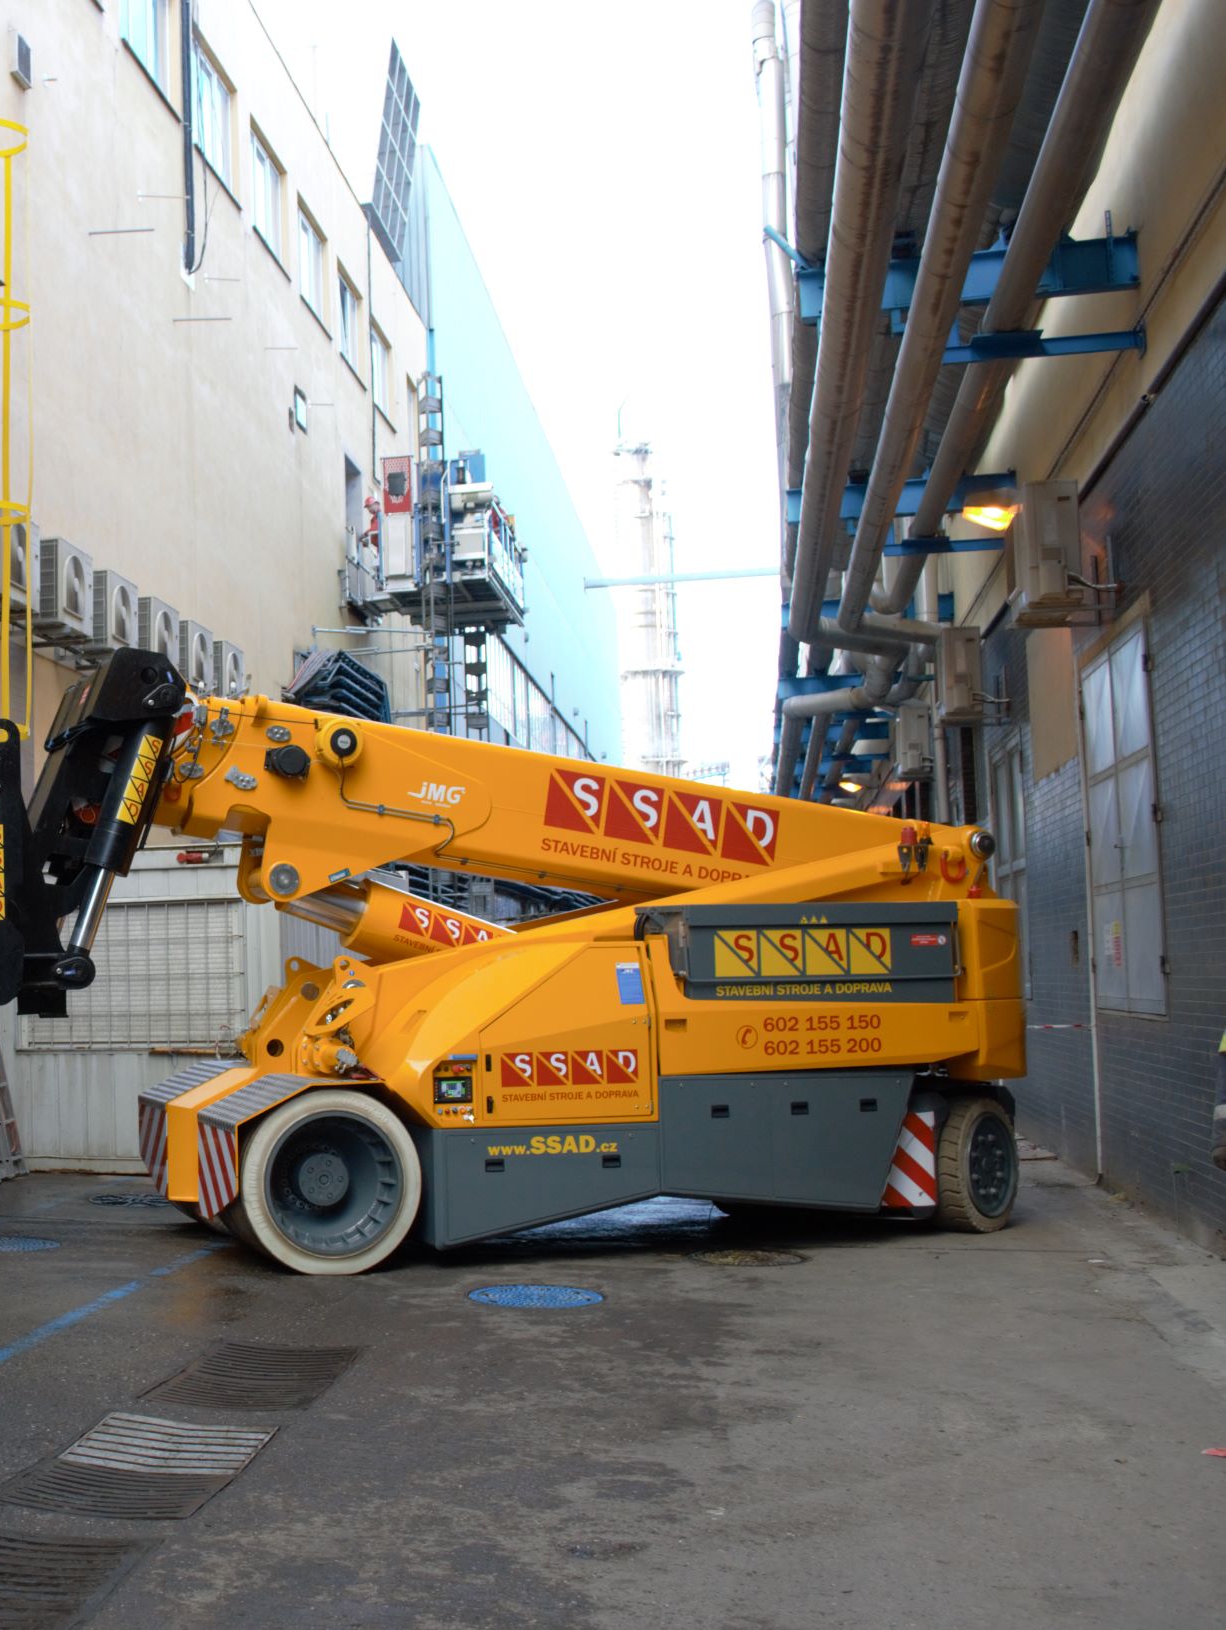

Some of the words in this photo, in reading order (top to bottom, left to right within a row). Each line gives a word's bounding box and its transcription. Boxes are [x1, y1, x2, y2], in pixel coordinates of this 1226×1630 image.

[573, 777, 774, 849] SSAD
[541, 837, 619, 864] STAVEBNÍ
[620, 852, 678, 874] STROJE
[682, 864, 693, 877] A
[698, 866, 751, 883] DOPR
[415, 907, 489, 942] SSA
[733, 932, 888, 963] SSAD
[716, 984, 774, 997] STAVEBNÍ
[776, 984, 822, 996] STROJE
[824, 984, 834, 995] A
[836, 982, 892, 994] DOPRAVA
[763, 1016, 799, 1032] 602
[805, 1015, 841, 1031] 155
[846, 1014, 881, 1030] 150
[764, 1040, 800, 1056] 602
[806, 1039, 841, 1055] 155
[846, 1037, 882, 1053] 200
[514, 1051, 636, 1078] SSAD
[502, 1091, 547, 1103] STAVEBNÍ
[549, 1092, 584, 1102] STROJE
[586, 1091, 593, 1100] A
[595, 1089, 639, 1099] DOPRAVA
[487, 1135, 618, 1156] www.SSAD.cz
